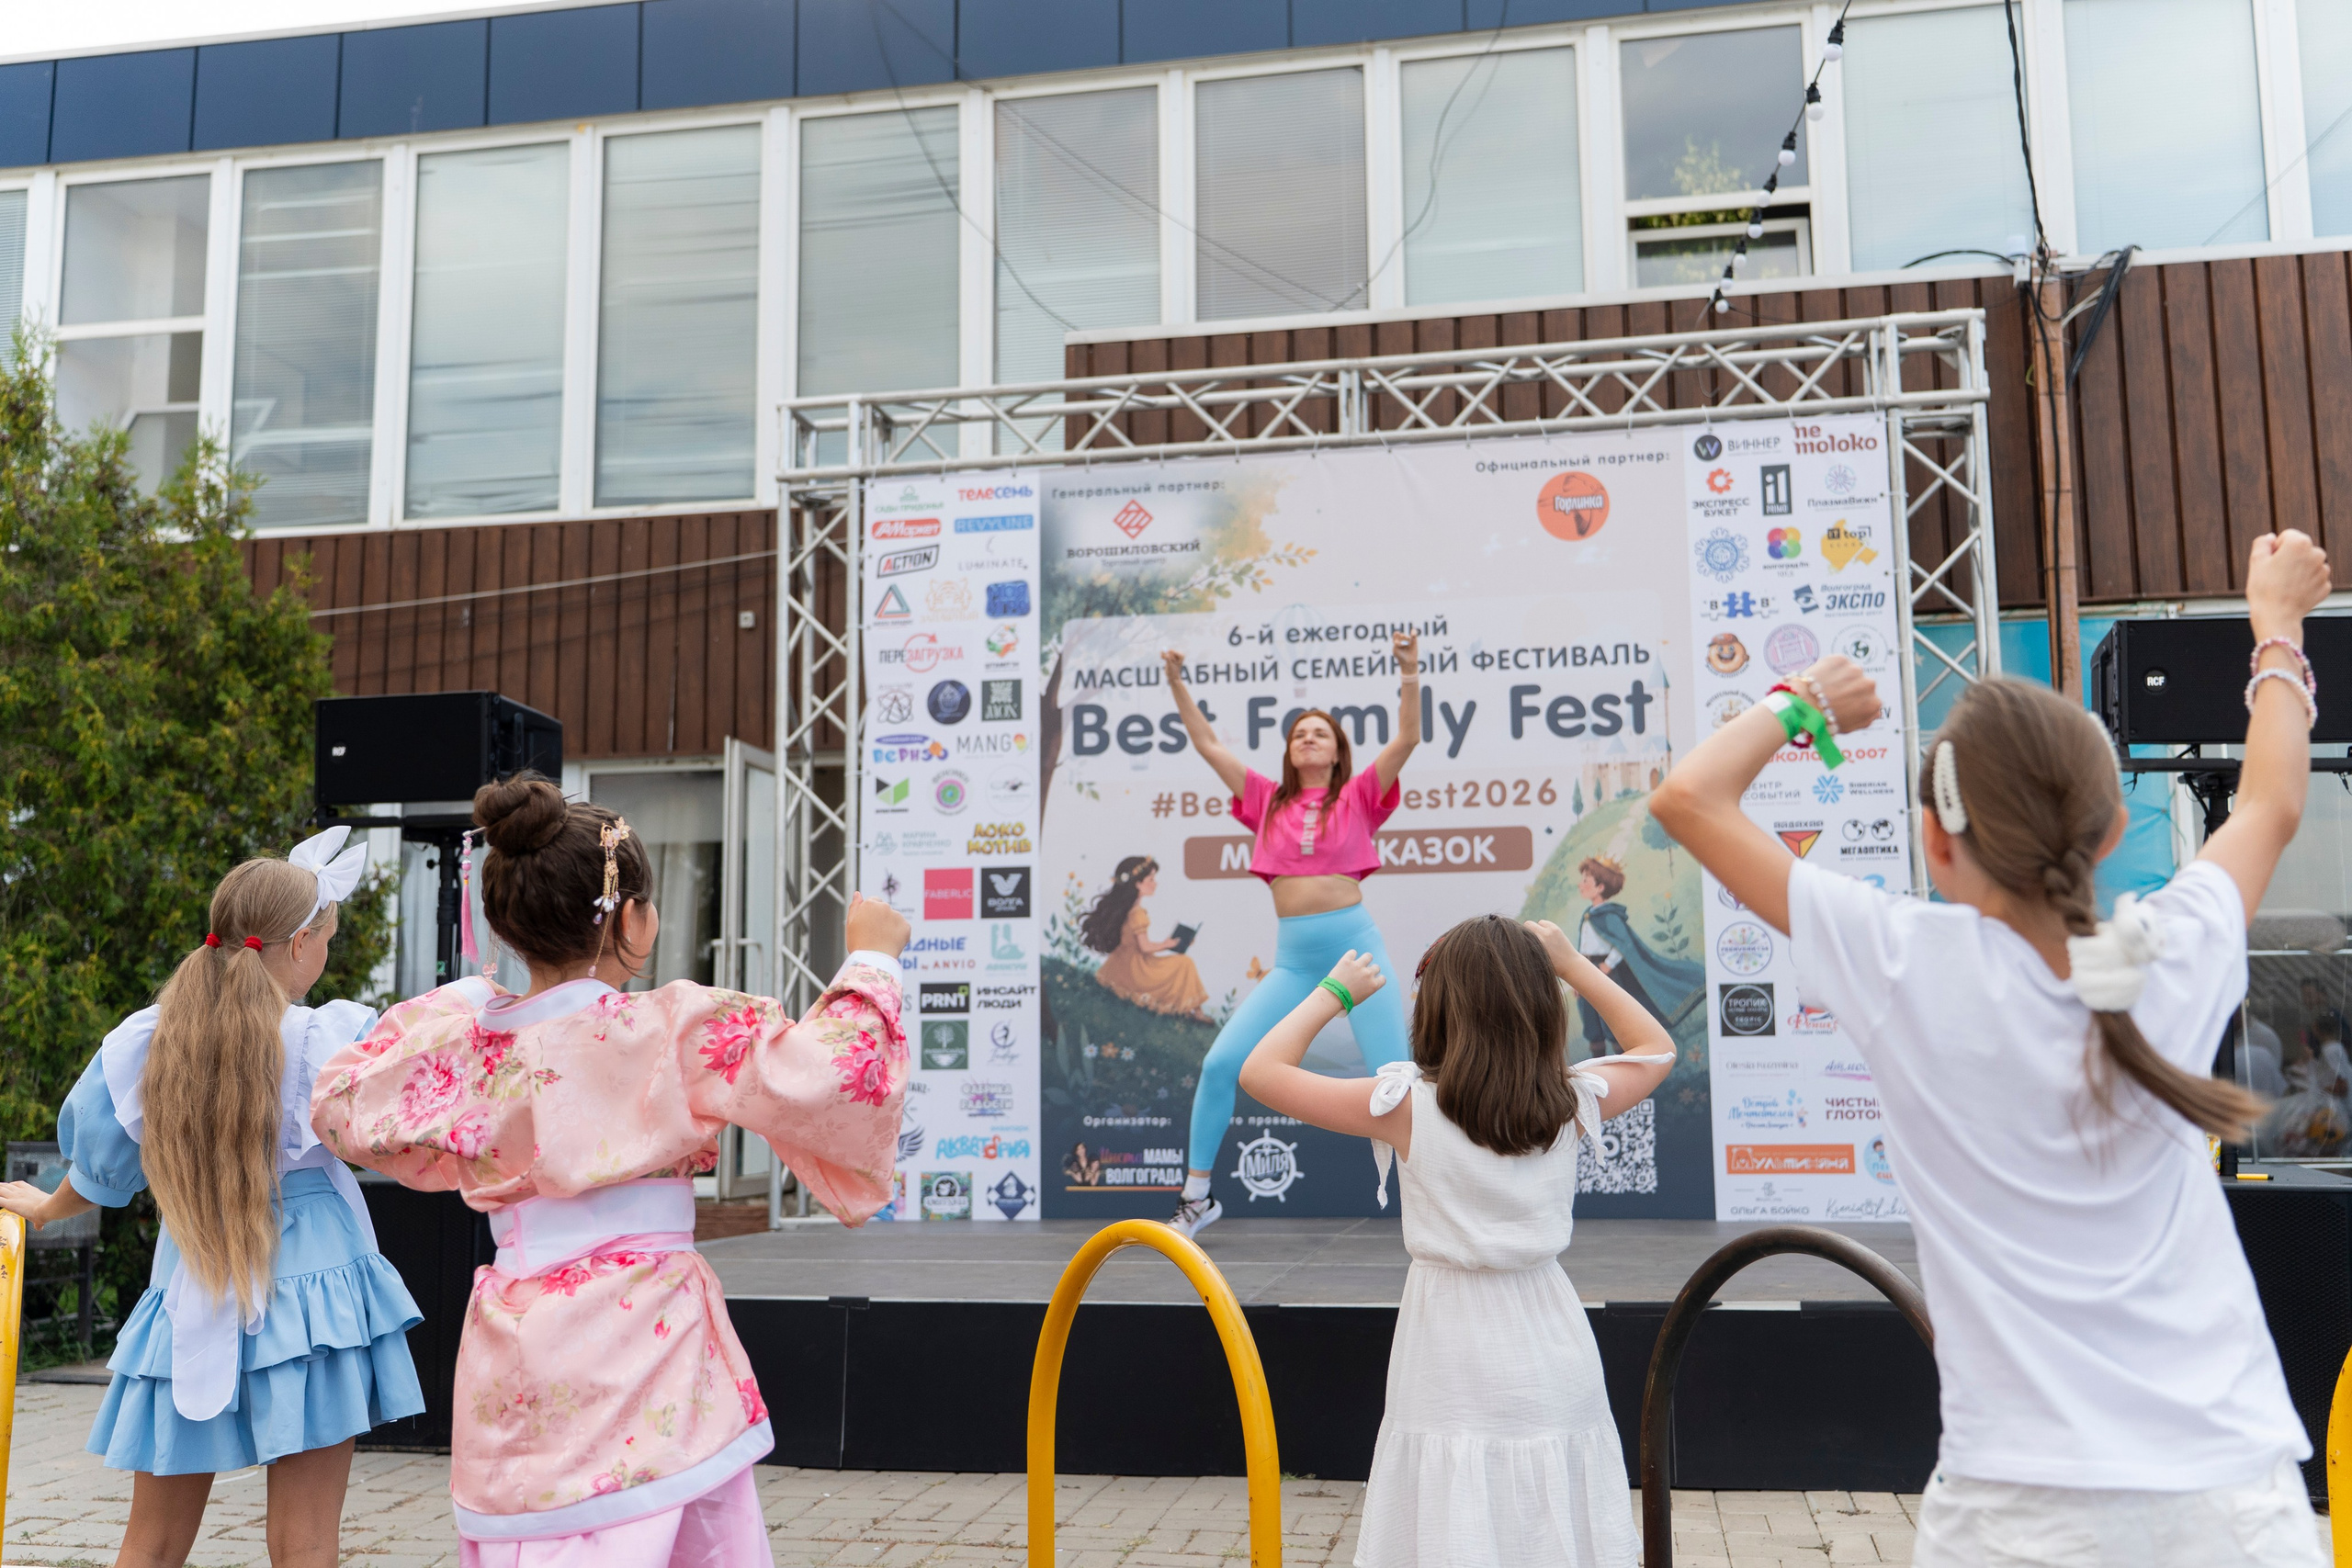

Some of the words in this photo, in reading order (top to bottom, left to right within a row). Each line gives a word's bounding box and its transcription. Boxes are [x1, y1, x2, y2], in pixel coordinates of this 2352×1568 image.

[1727, 437, 1780, 452] ВИННЕР
[1793, 434, 1877, 456] moloko
[1476, 457, 1590, 473] Официальный
[1598, 452, 1669, 466] партнер:
[1052, 484, 1151, 499] Генеральный
[1158, 480, 1225, 492] партнер:
[1692, 497, 1749, 510] ЭКСПРЕСС
[1766, 503, 1788, 513] PRIMO
[1703, 508, 1737, 518] БУКЕТ
[957, 516, 1031, 533] REVYLINE
[1068, 539, 1200, 558] ВОРОШИЛОВСКИЙ
[1826, 592, 1885, 611] ЭКСПО
[1227, 624, 1273, 646] 6-й
[879, 647, 965, 663] ПЕРЕЗАГРУЗКА
[1074, 656, 1278, 689] МАСШАБНЫЙ
[1471, 643, 1650, 671] ФЕСТИВАЛЬ
[2146, 676, 2165, 686] RCF
[1248, 685, 1476, 759] Fmly
[1510, 680, 1653, 739] Fest
[1743, 789, 1801, 800] СОБЫТИЙ
[1372, 835, 1496, 866] КАЗОК
[1840, 846, 1899, 855] МЕГАОПТИКА
[924, 888, 974, 899] FABERLIC
[988, 897, 1024, 908] ВОЛГА
[933, 959, 976, 969] ANVIO
[977, 985, 1037, 996] ИНСАЙТ
[977, 999, 1022, 1010] ЛЮДИ
[1728, 998, 1767, 1007] ТРОПИК
[1825, 1097, 1880, 1108] ЧИСТЫ
[1082, 1115, 1172, 1128] Организатор:
[1105, 1168, 1183, 1185] ВОЛГОГРАДА
[1730, 1206, 1768, 1215] ОЛЬГА
[1770, 1203, 1810, 1214] БОЙКО
